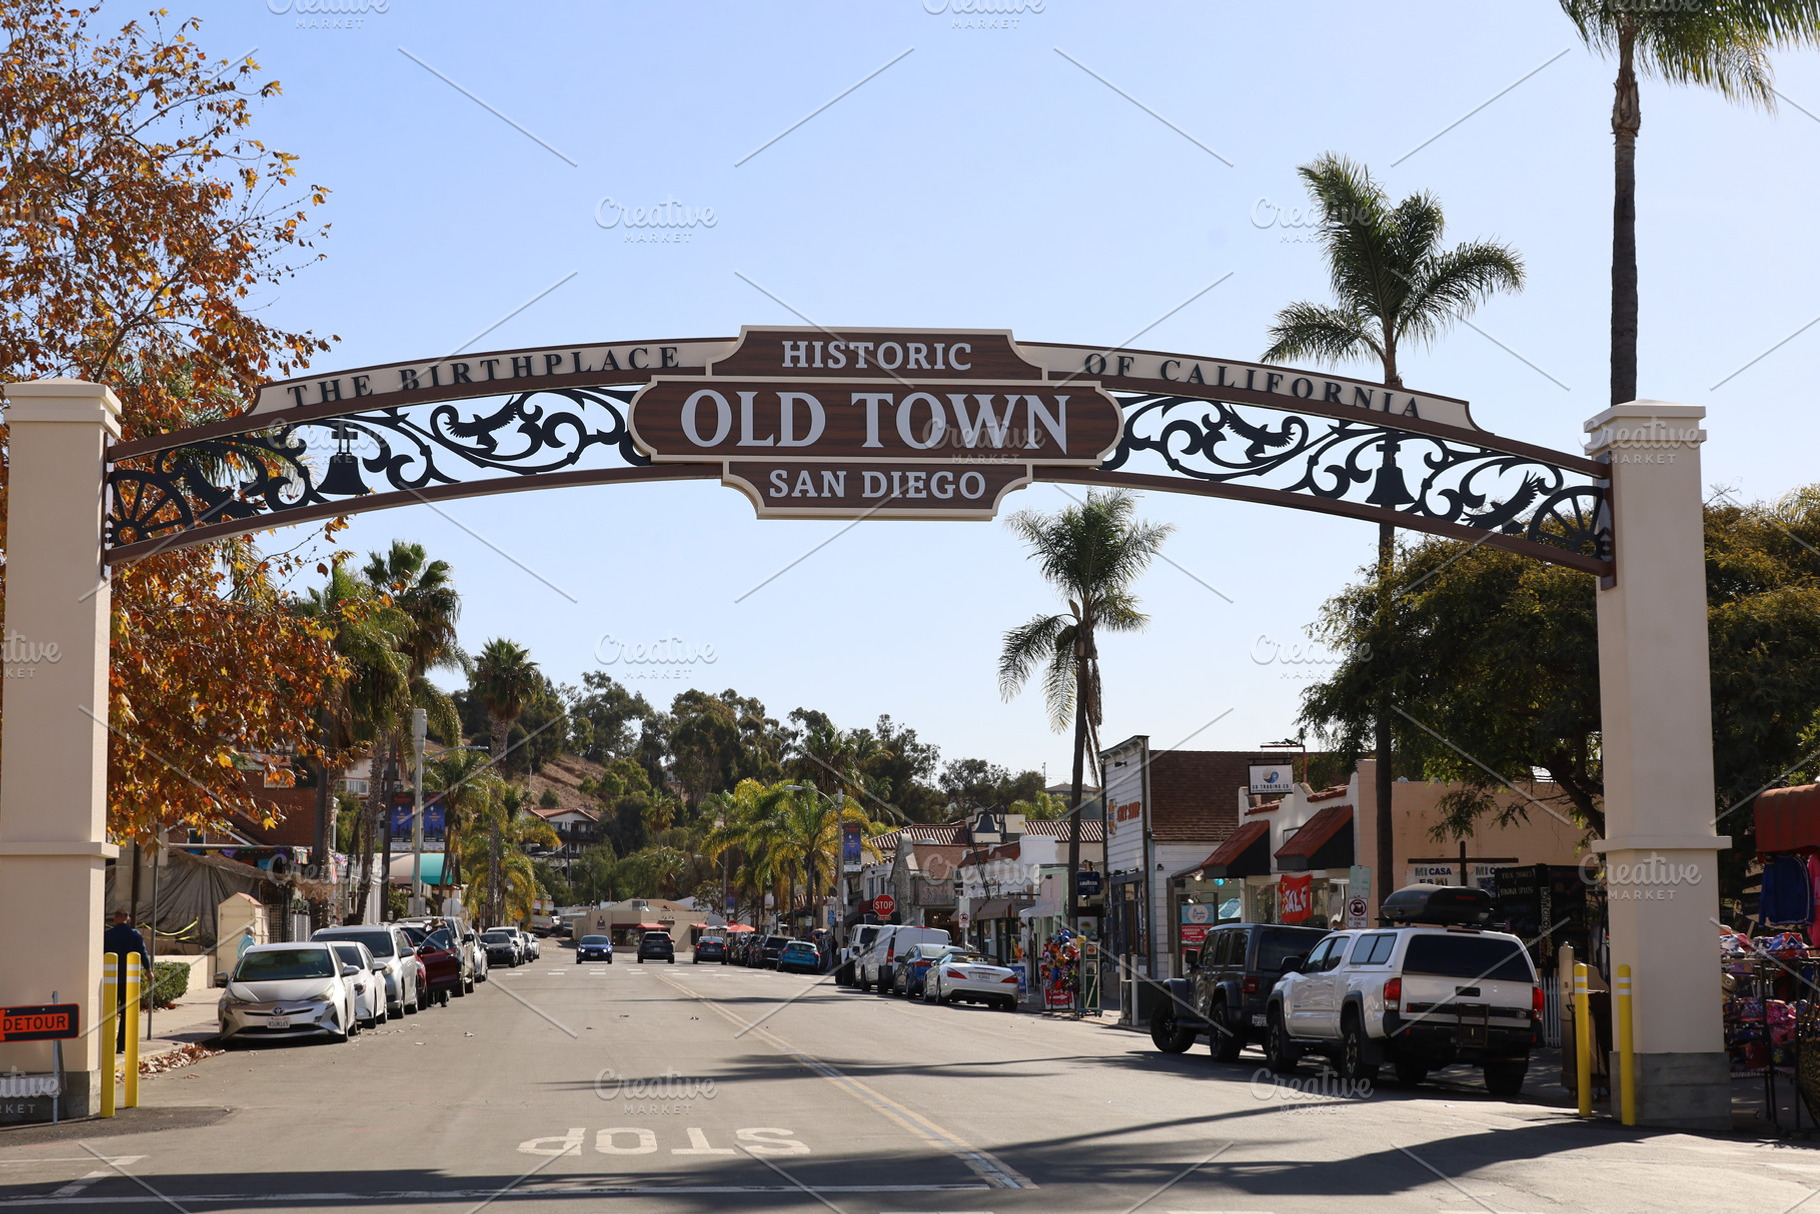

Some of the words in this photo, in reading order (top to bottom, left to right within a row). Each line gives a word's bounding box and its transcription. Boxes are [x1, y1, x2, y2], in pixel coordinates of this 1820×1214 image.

[781, 341, 972, 371] HISTORIC
[287, 375, 374, 407] THE
[398, 346, 679, 392] BIRTHPLACE
[1083, 352, 1134, 378] OF
[1160, 359, 1421, 418] CALIFORNIA
[680, 389, 827, 448] OLD
[850, 392, 1072, 456] TOWN
[769, 469, 847, 499] SAN
[861, 470, 986, 500] DIEGO
[1430, 867, 1452, 875] CASA
[875, 901, 893, 910] STOP
[3, 1015, 66, 1031] DETOUR
[517, 1127, 811, 1157] STOP
